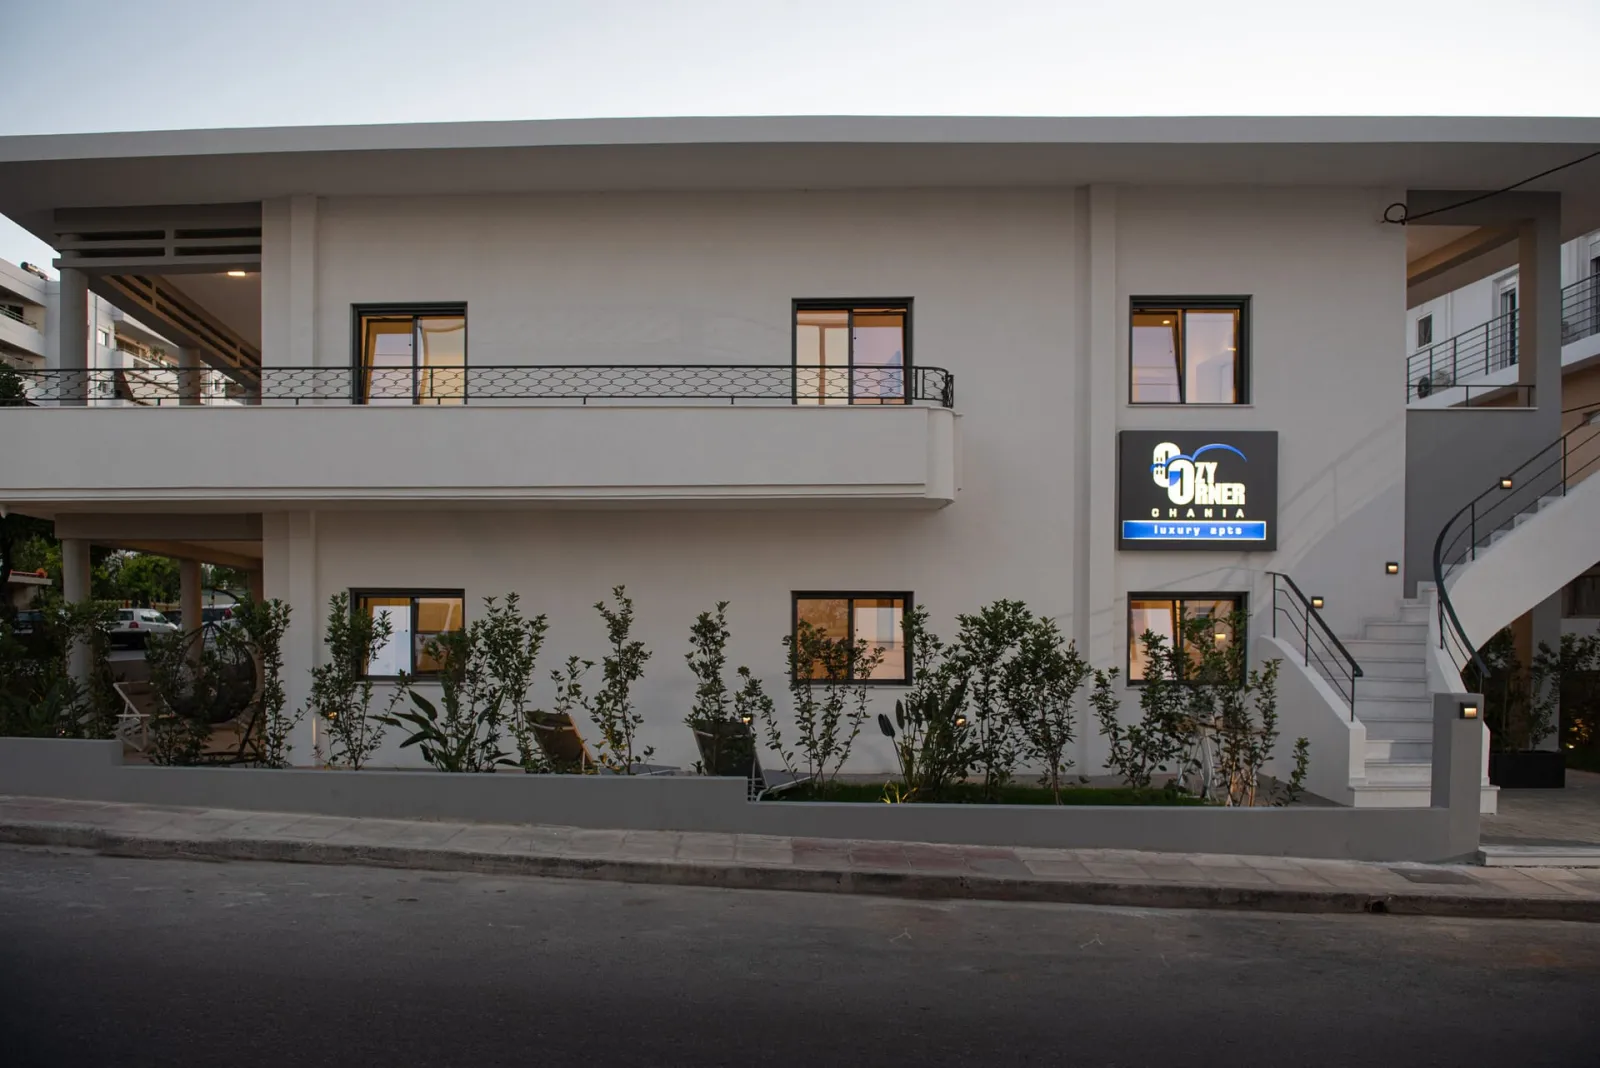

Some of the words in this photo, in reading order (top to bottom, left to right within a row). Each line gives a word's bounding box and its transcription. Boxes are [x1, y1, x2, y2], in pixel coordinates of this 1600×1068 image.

[1151, 508, 1244, 518] CHANIA
[1154, 525, 1200, 536] luxury
[1210, 525, 1242, 536] apts
